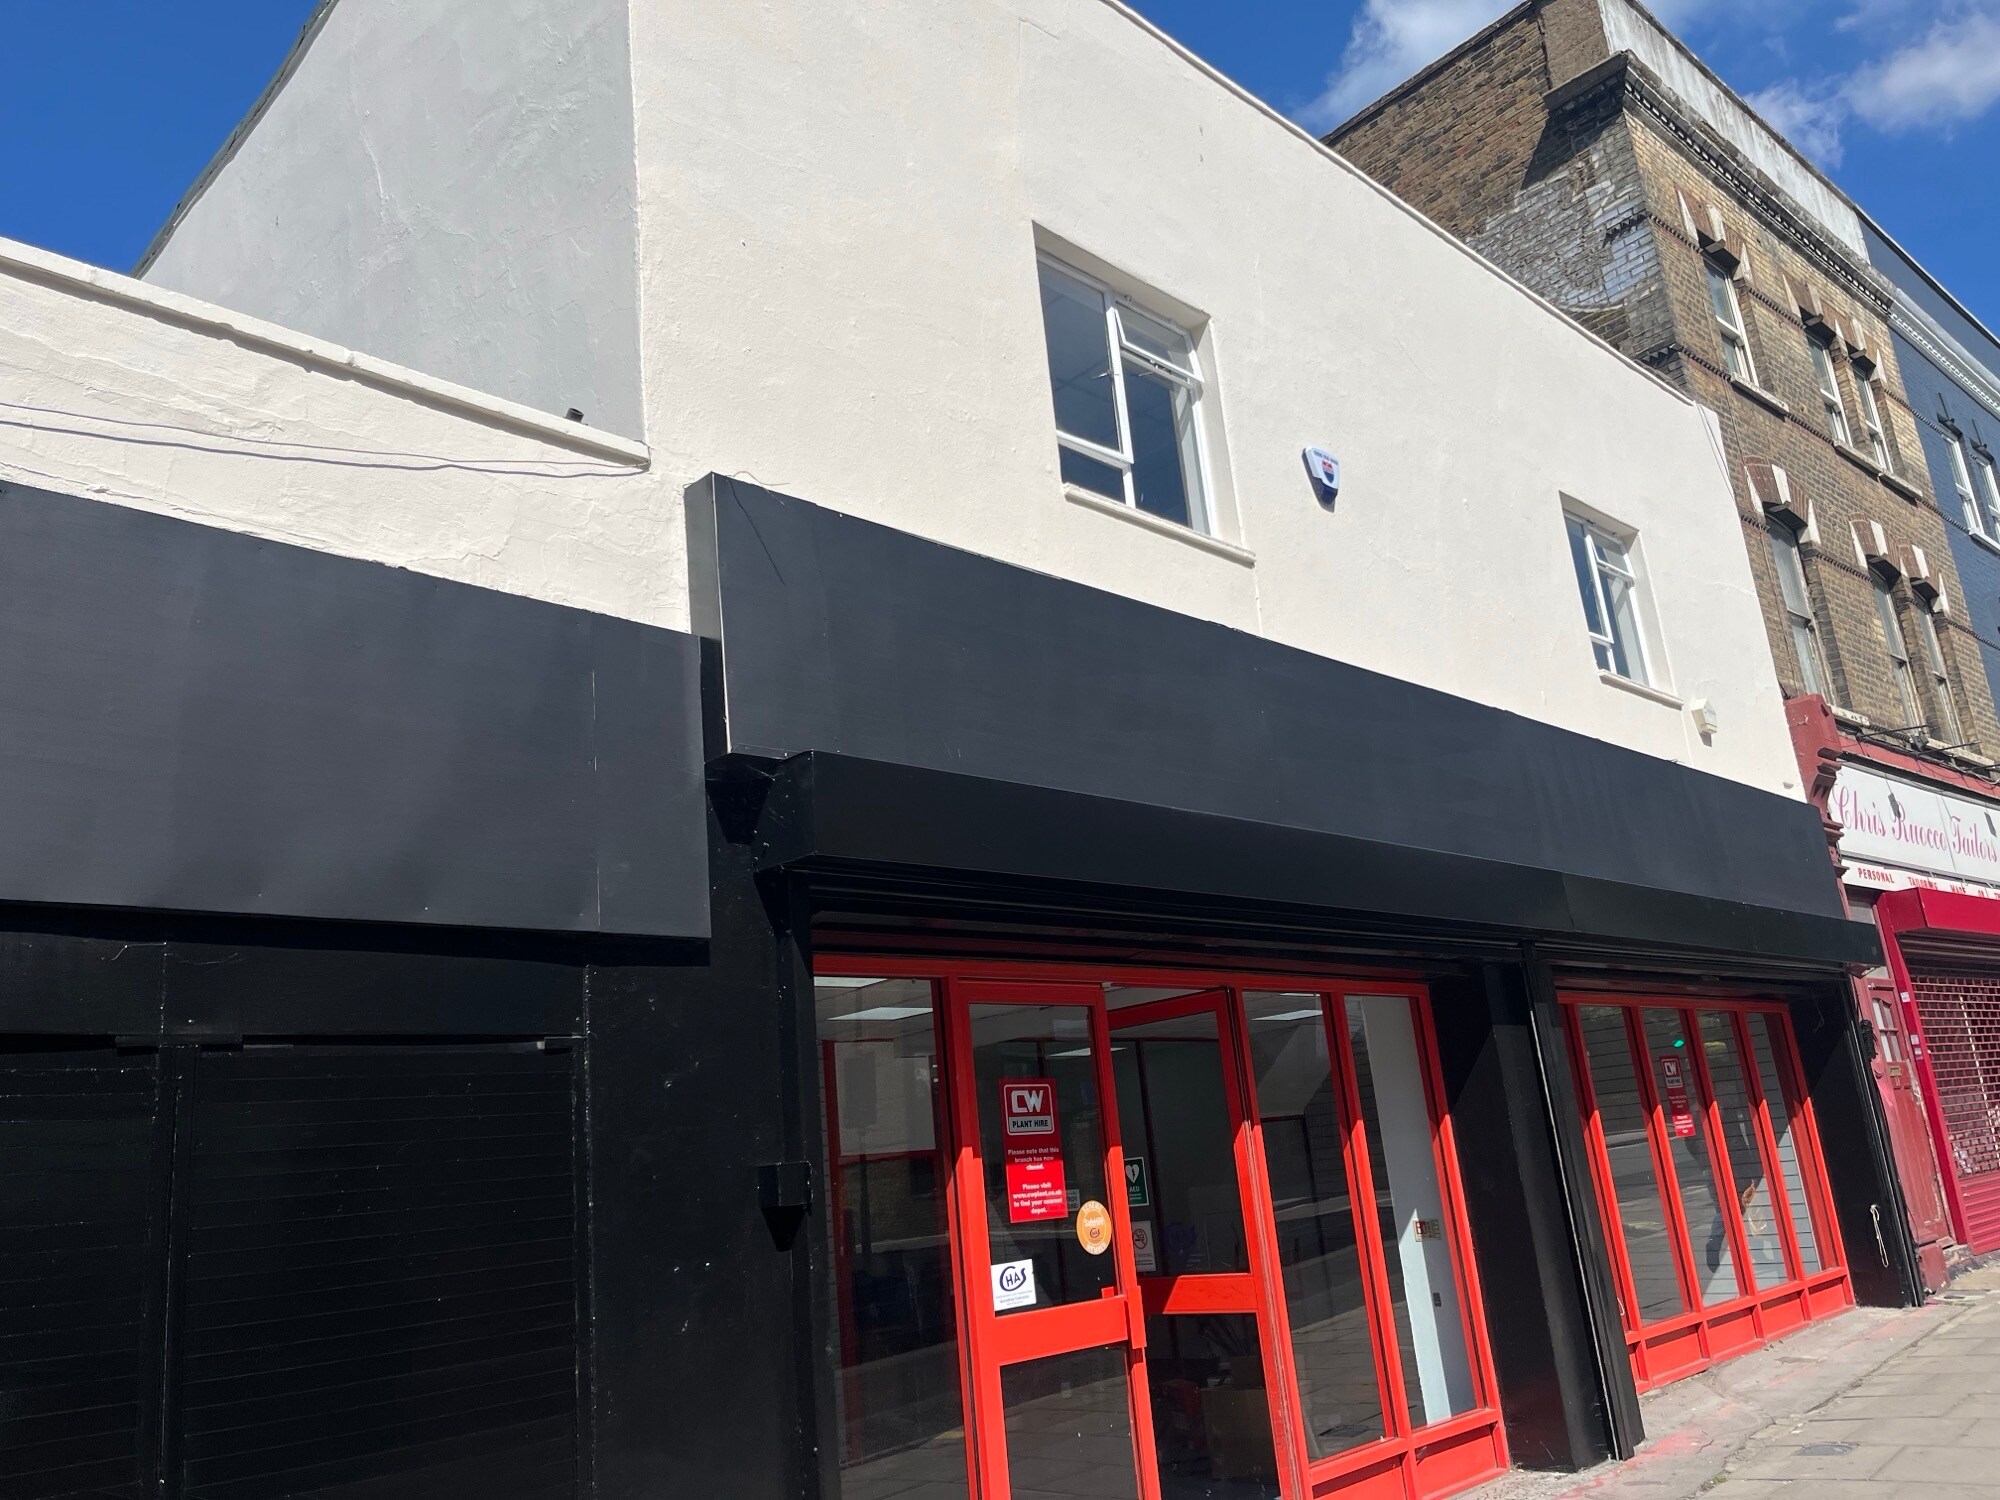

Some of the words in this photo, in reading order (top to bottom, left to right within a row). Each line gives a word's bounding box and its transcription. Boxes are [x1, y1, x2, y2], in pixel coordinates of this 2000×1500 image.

[1832, 786, 1887, 837] Chris
[1951, 815, 1997, 863] Tailors
[1857, 867, 1895, 884] PERSONAL
[1011, 1090, 1044, 1113] CW
[1012, 1120, 1032, 1128] PLANT
[1034, 1119, 1048, 1127] HIRE
[999, 1266, 1027, 1291] CHAS
